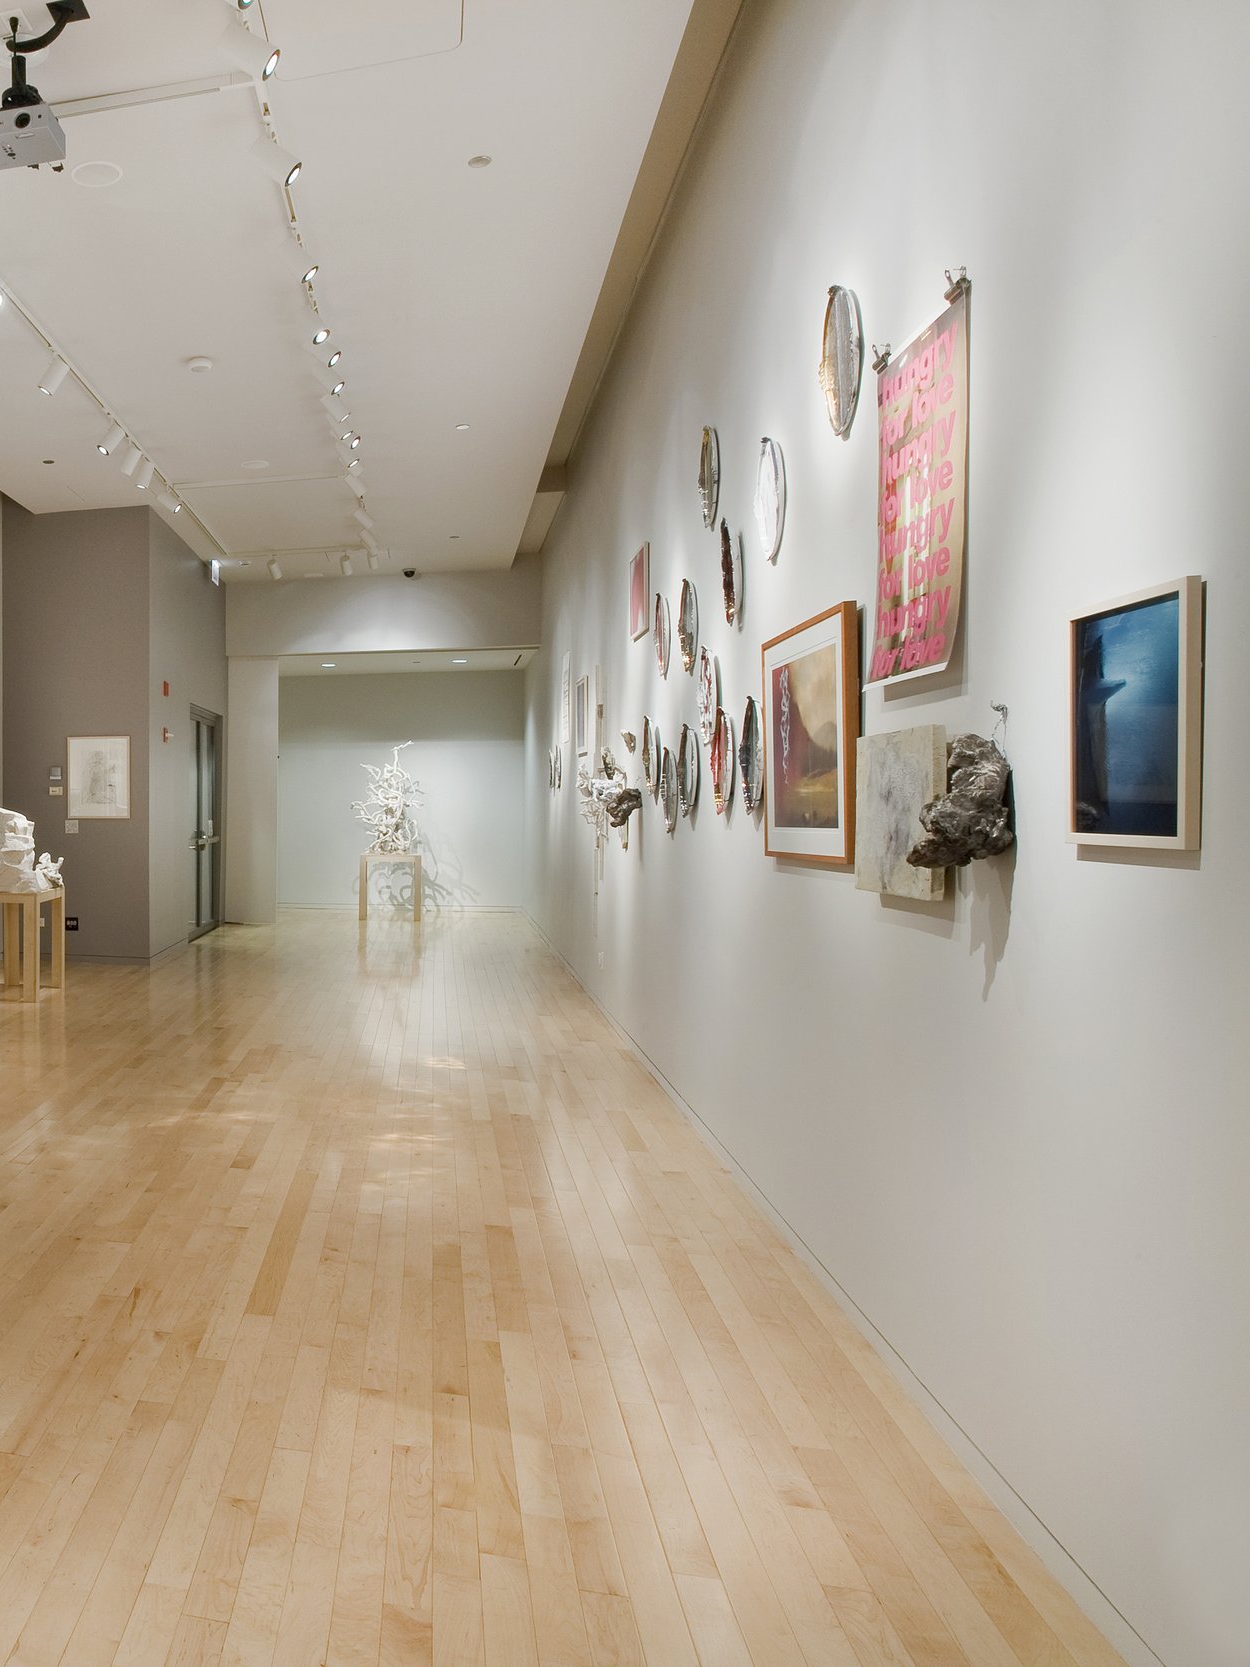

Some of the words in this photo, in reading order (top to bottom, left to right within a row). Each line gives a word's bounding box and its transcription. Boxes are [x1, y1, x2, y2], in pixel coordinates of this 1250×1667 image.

[881, 320, 957, 410] hungry
[881, 407, 909, 450] for
[911, 373, 954, 429] love
[881, 410, 956, 486] hungry
[881, 488, 904, 523] for
[909, 460, 953, 509] love
[879, 497, 955, 562] hungry
[878, 567, 903, 601] for
[908, 546, 950, 589] love
[878, 586, 950, 639] hungry
[871, 645, 899, 679] for
[900, 633, 945, 670] love
